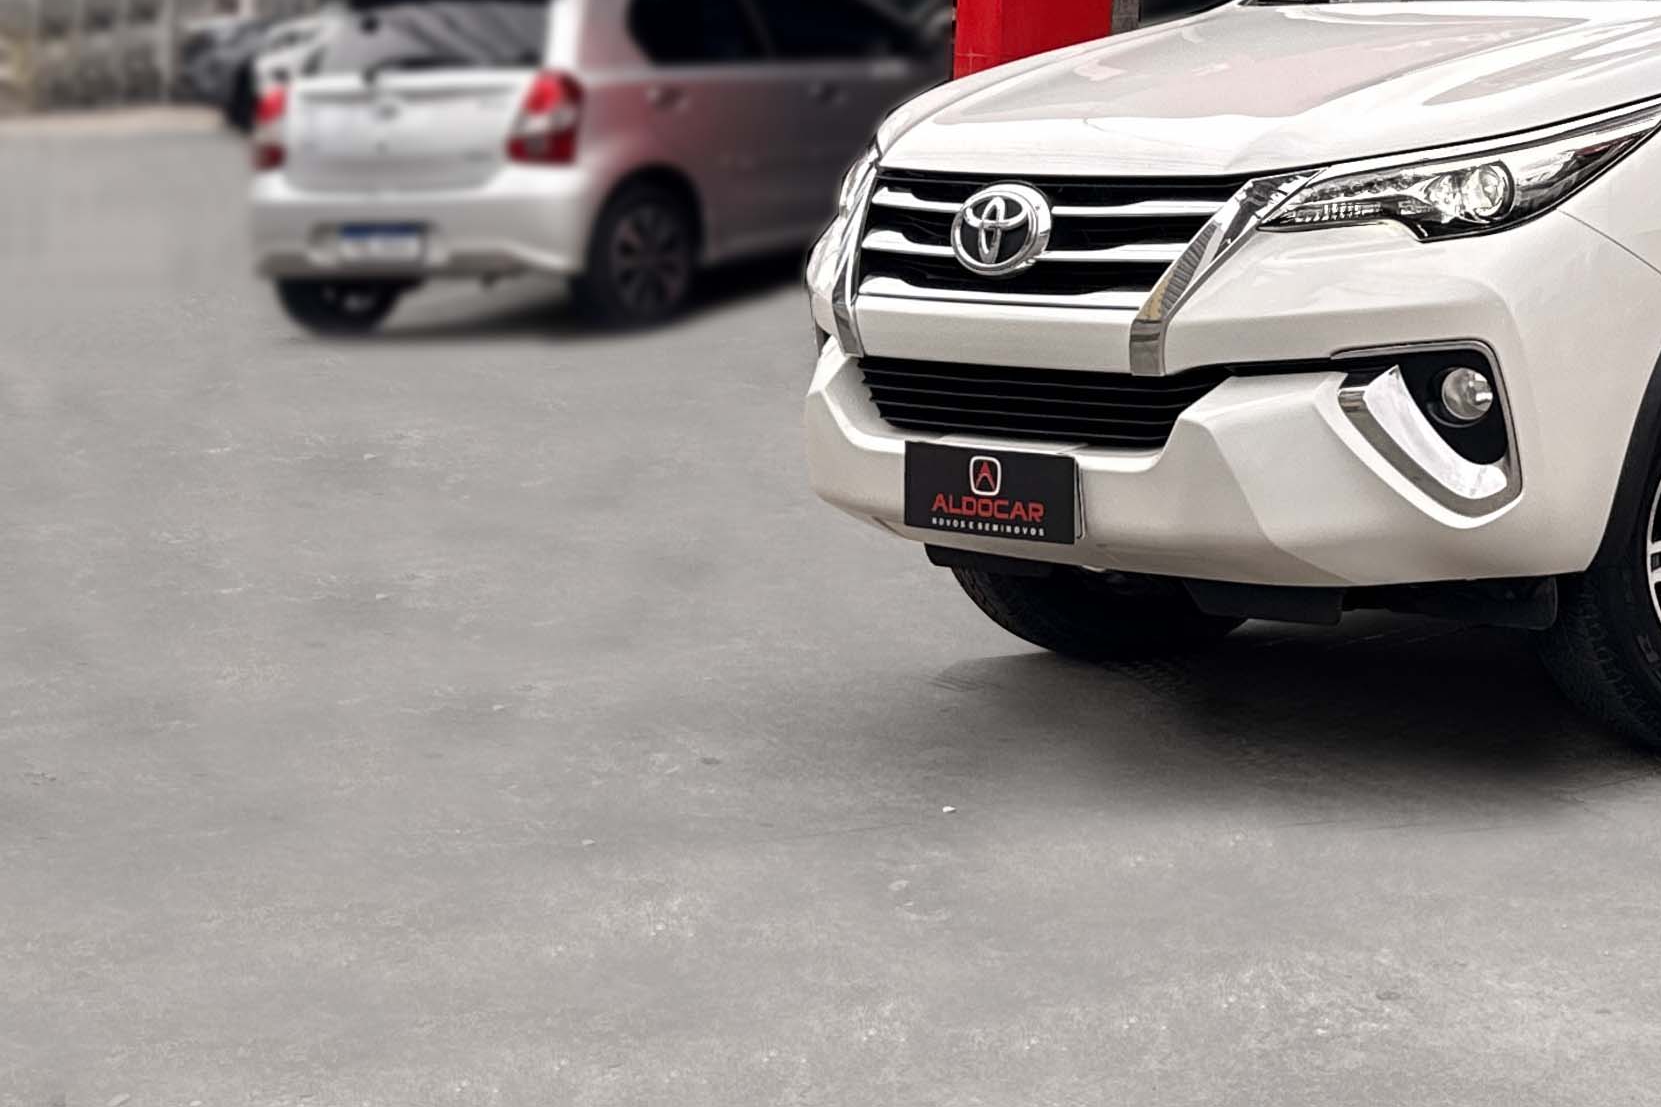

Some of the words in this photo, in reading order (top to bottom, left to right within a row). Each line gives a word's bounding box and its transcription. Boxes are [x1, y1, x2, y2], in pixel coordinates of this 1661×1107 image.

[931, 493, 1045, 523] ALDOCAR
[931, 517, 966, 529] NOVOS
[977, 522, 1045, 537] SEMINOVOS
